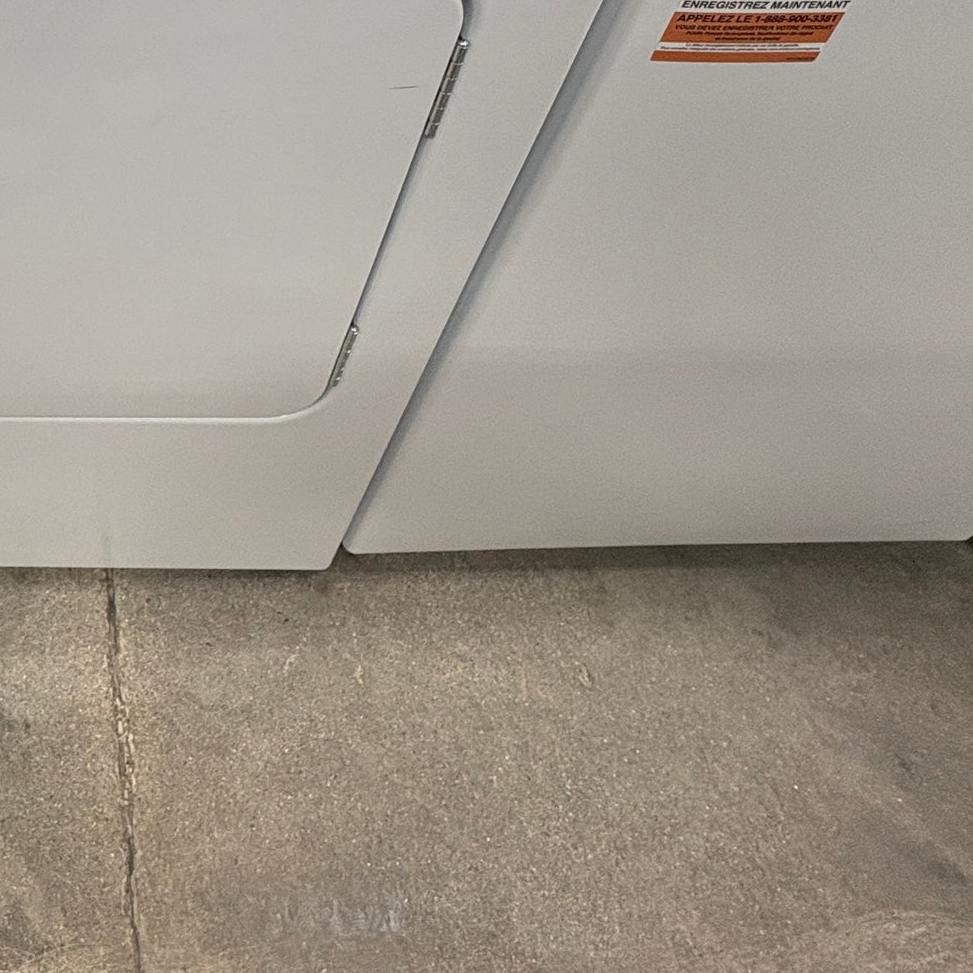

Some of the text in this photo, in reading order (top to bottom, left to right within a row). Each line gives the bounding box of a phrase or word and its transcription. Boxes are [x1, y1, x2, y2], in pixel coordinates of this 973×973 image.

[681, 0, 852, 9] ENREGISTREZ MAINTENANT
[677, 15, 734, 23] APPELEZ
[754, 14, 838, 23] 1-888-900-3381
